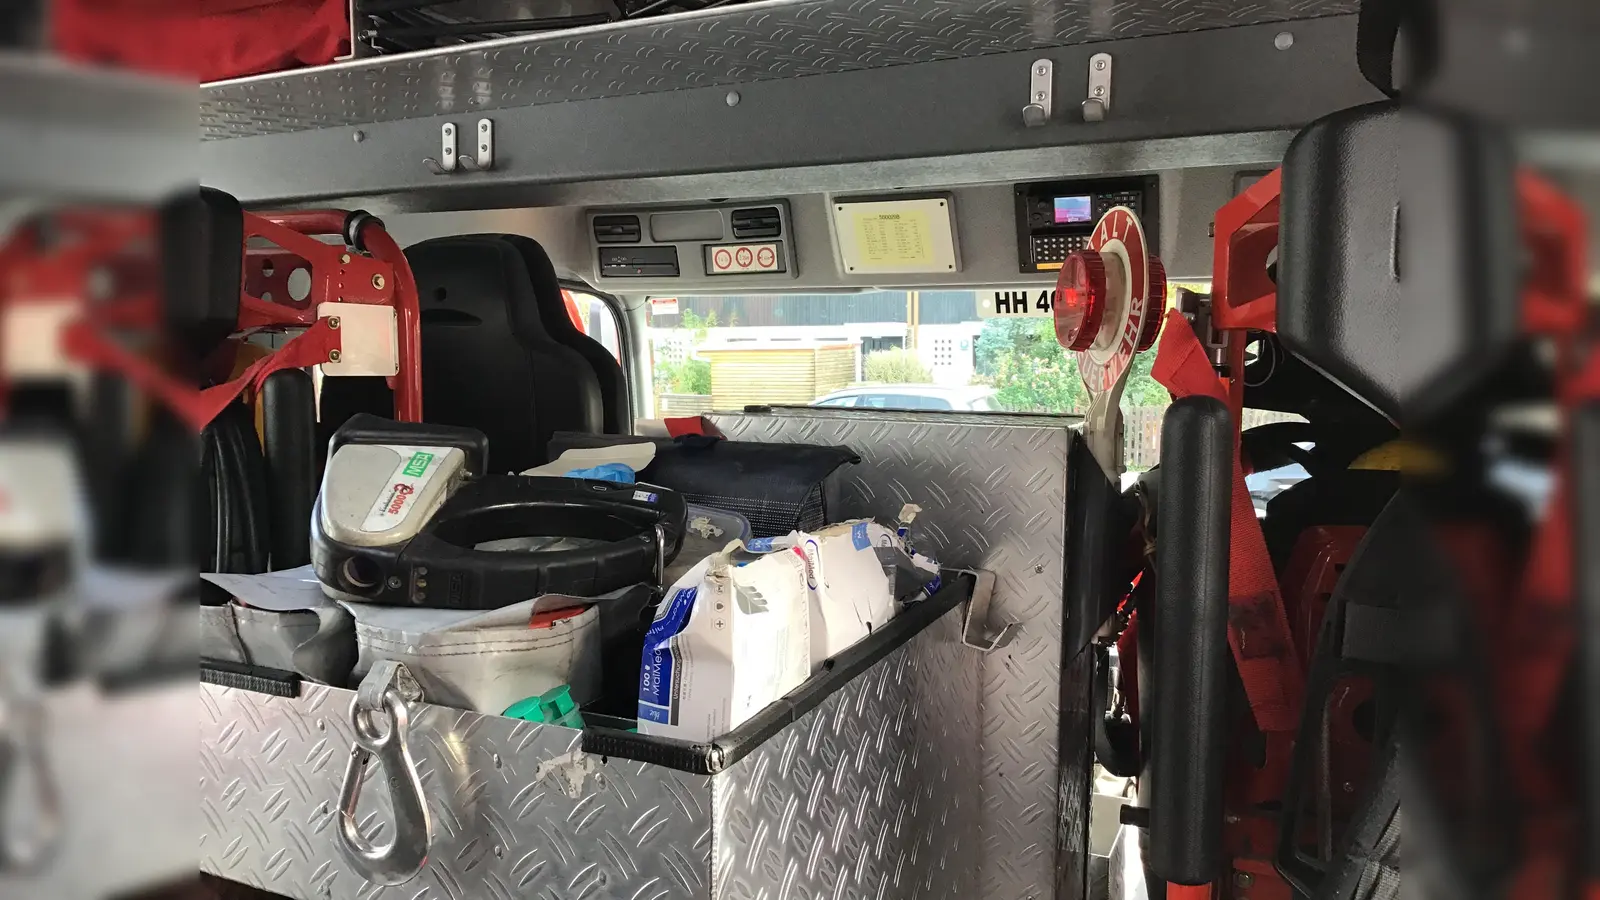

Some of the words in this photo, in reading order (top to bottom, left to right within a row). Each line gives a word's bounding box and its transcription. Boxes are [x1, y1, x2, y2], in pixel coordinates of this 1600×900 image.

[1089, 211, 1133, 250] ALT
[995, 291, 1028, 314] HH
[407, 453, 431, 476] MSA
[388, 494, 407, 514] 5000
[643, 673, 651, 692] 100
